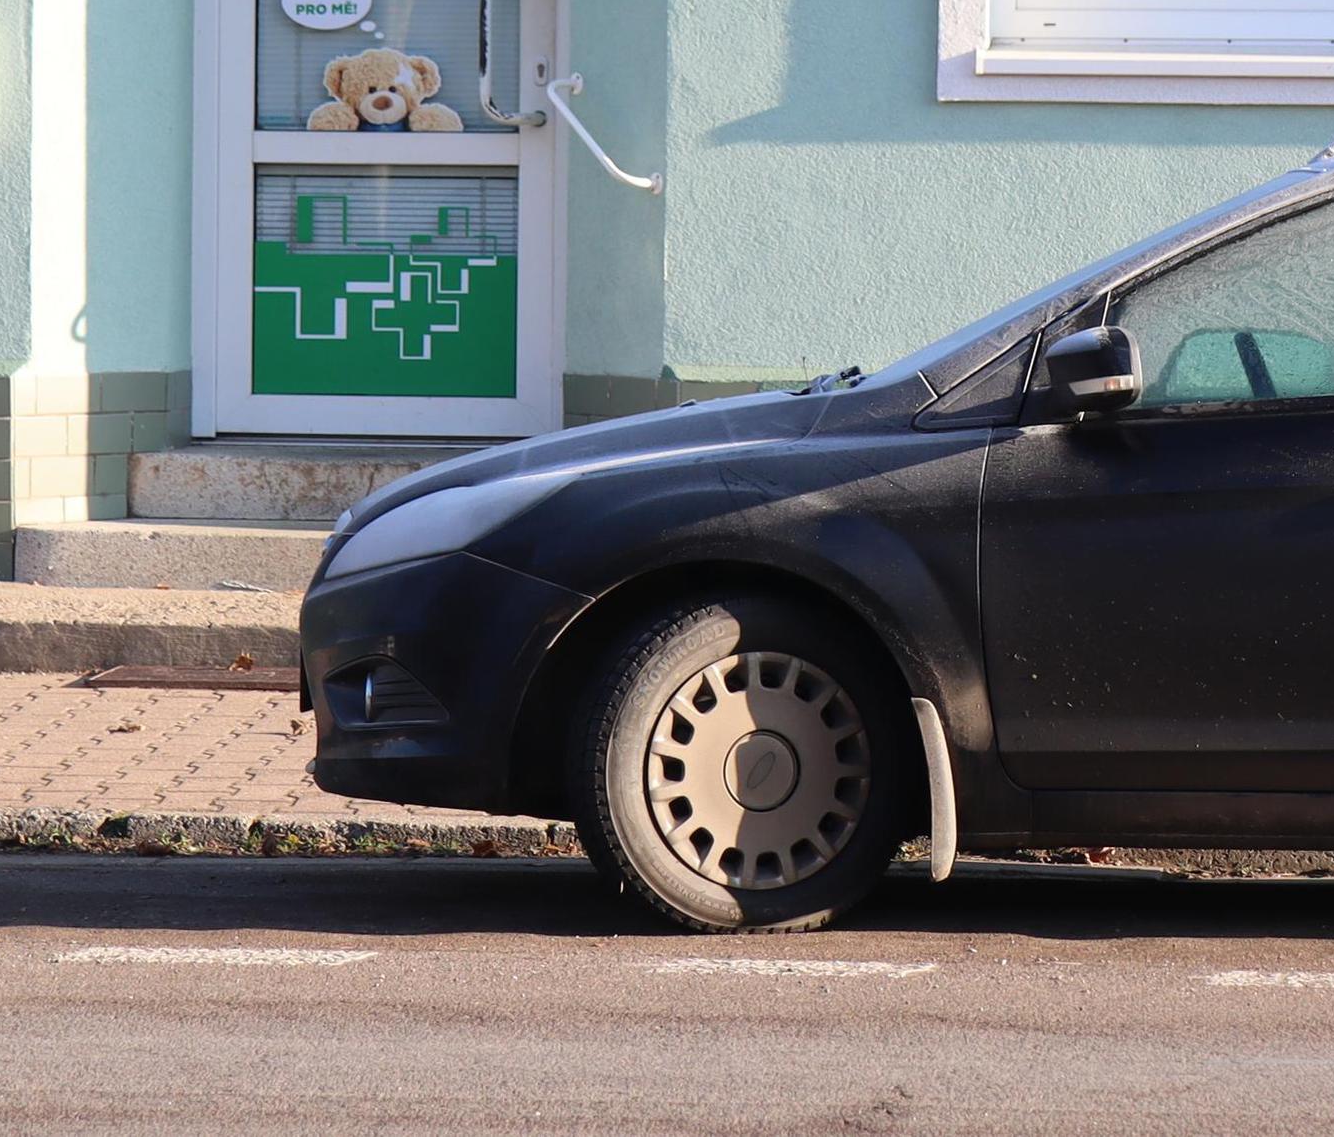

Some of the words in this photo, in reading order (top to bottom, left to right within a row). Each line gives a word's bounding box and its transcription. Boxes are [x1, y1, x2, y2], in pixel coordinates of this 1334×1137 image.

[296, 4, 327, 15] PRO
[331, 0, 357, 15] MĚ!
[631, 623, 725, 708] SNOWROAD
